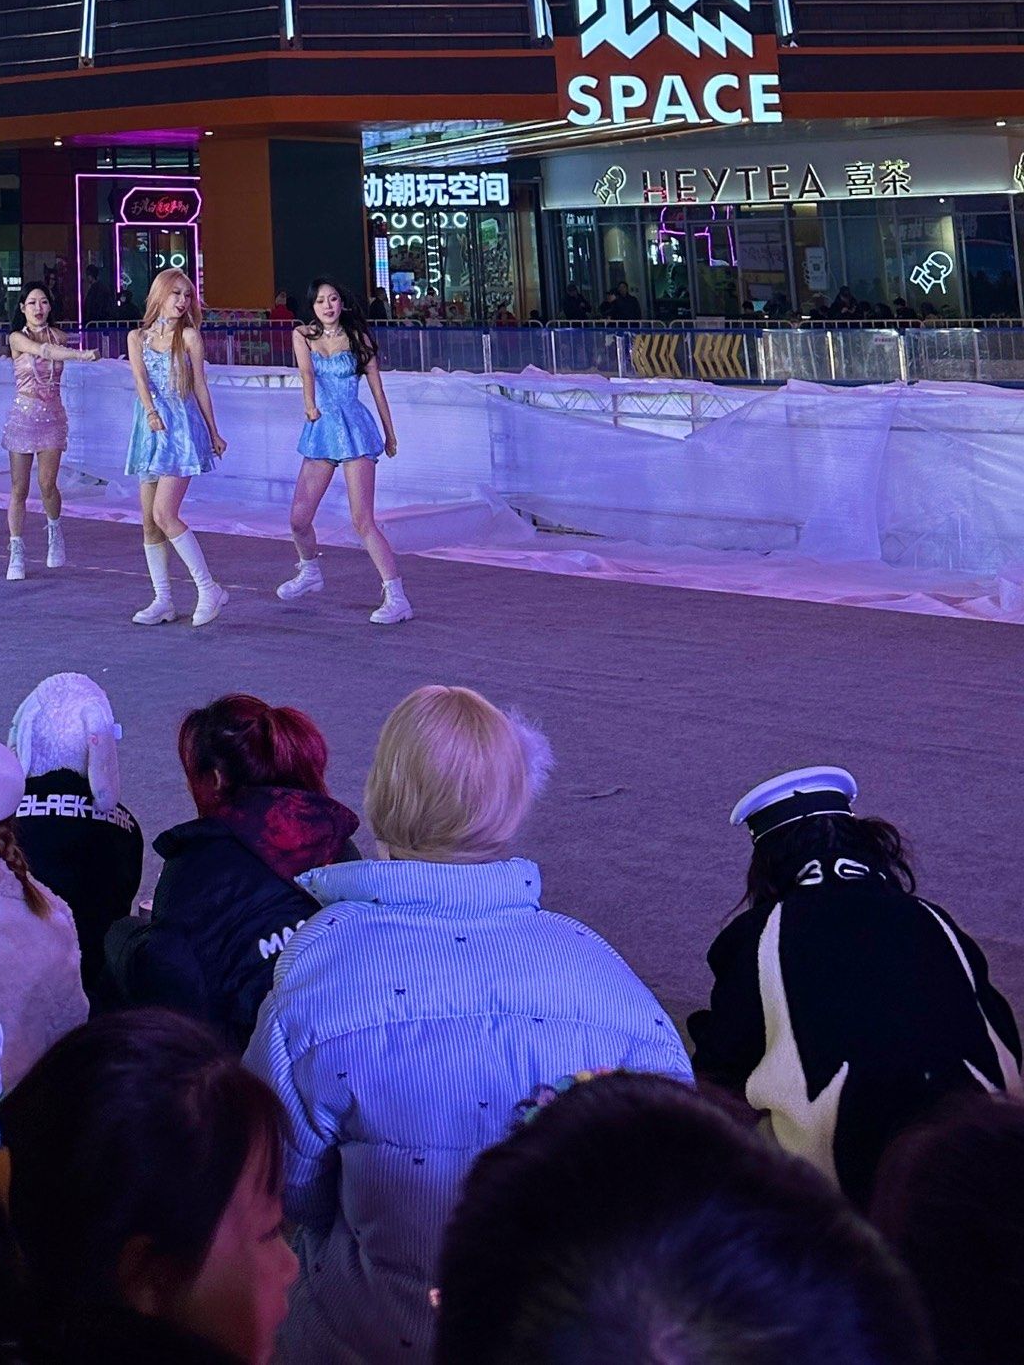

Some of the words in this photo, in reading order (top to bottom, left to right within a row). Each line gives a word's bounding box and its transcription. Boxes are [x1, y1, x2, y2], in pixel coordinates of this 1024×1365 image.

[567, 74, 782, 126] SPACE
[642, 164, 826, 203] HEYTEA
[844, 160, 912, 195] 喜茶
